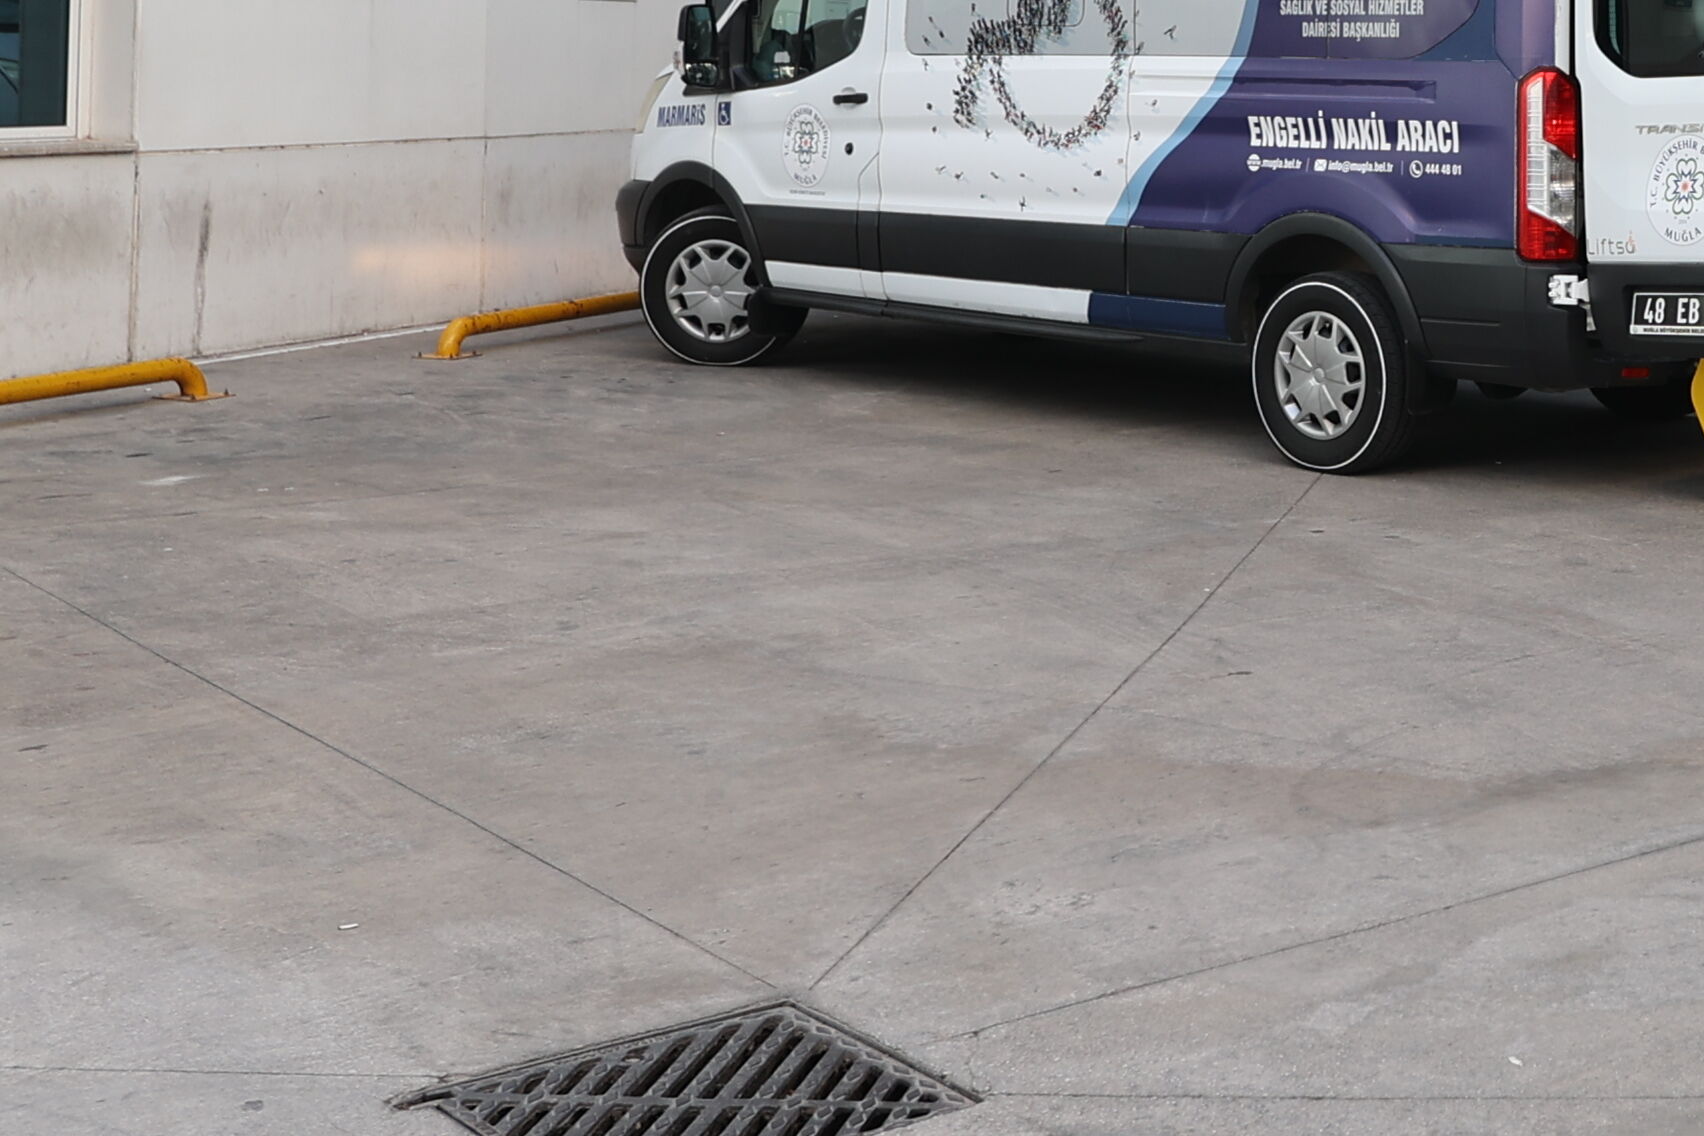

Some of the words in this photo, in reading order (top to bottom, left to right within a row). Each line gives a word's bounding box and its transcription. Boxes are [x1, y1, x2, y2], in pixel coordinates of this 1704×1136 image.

[1315, 0, 1328, 15] VE
[1330, 0, 1366, 16] SOSYAL
[1302, 18, 1340, 37] DAİRESİ
[1342, 18, 1400, 42] BAŞKANLIĞI
[1248, 110, 1328, 149] ENGELLİ
[1331, 111, 1392, 152] NAKİL
[1396, 119, 1460, 154] ARACI
[1425, 163, 1440, 175] 444
[1441, 163, 1451, 175] 48
[1452, 164, 1462, 175] 01
[1664, 227, 1702, 242] MUĞLA
[1643, 297, 1666, 324] 48
[1677, 297, 1700, 324] EB
